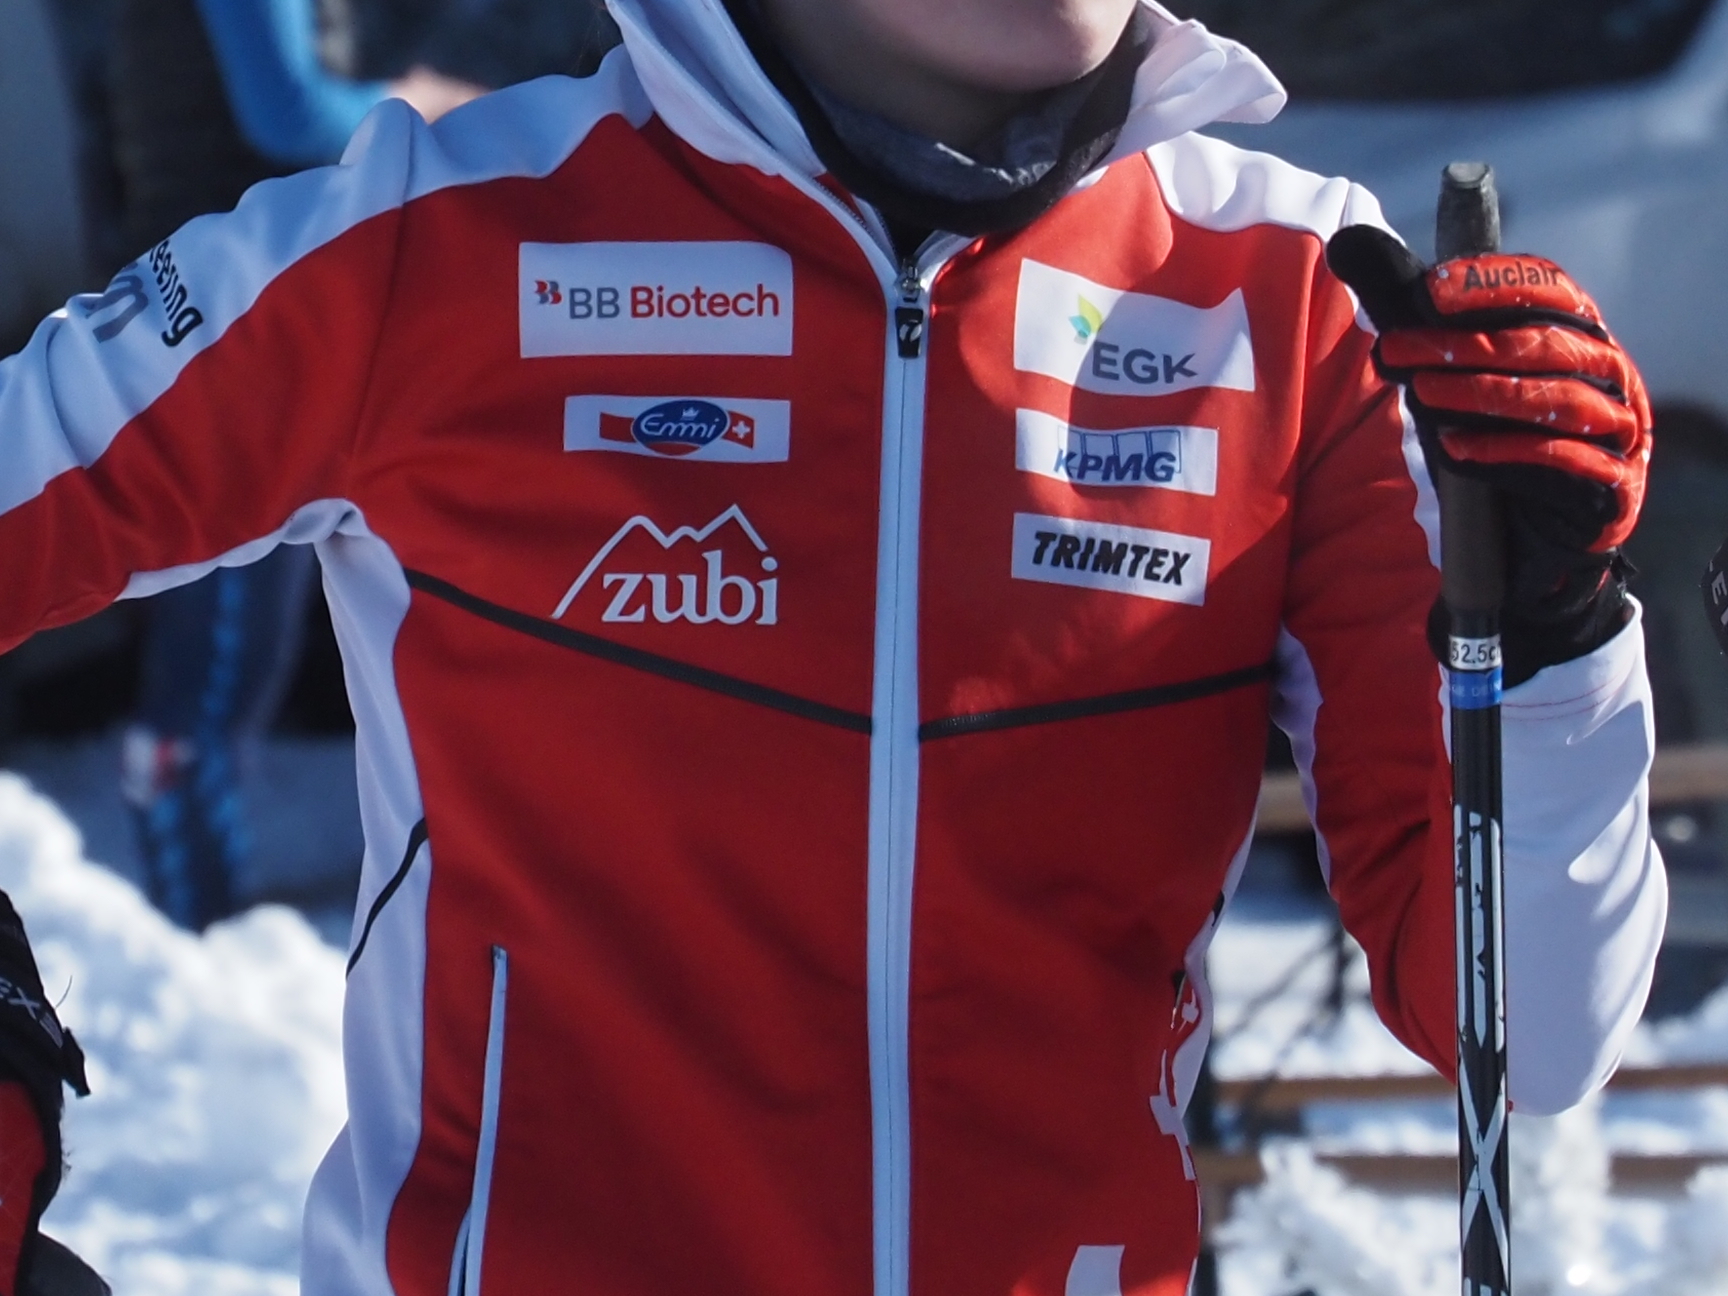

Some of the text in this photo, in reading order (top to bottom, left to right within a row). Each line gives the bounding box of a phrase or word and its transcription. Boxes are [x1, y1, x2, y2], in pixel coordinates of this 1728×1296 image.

[1463, 261, 1563, 291] Auclair
[569, 284, 780, 319] BB Biotech
[1090, 341, 1199, 384] EGK
[640, 410, 720, 446] Emmi
[1053, 446, 1177, 483] KPMG
[1031, 531, 1193, 586] TRIMTEX
[601, 549, 779, 626] zubi
